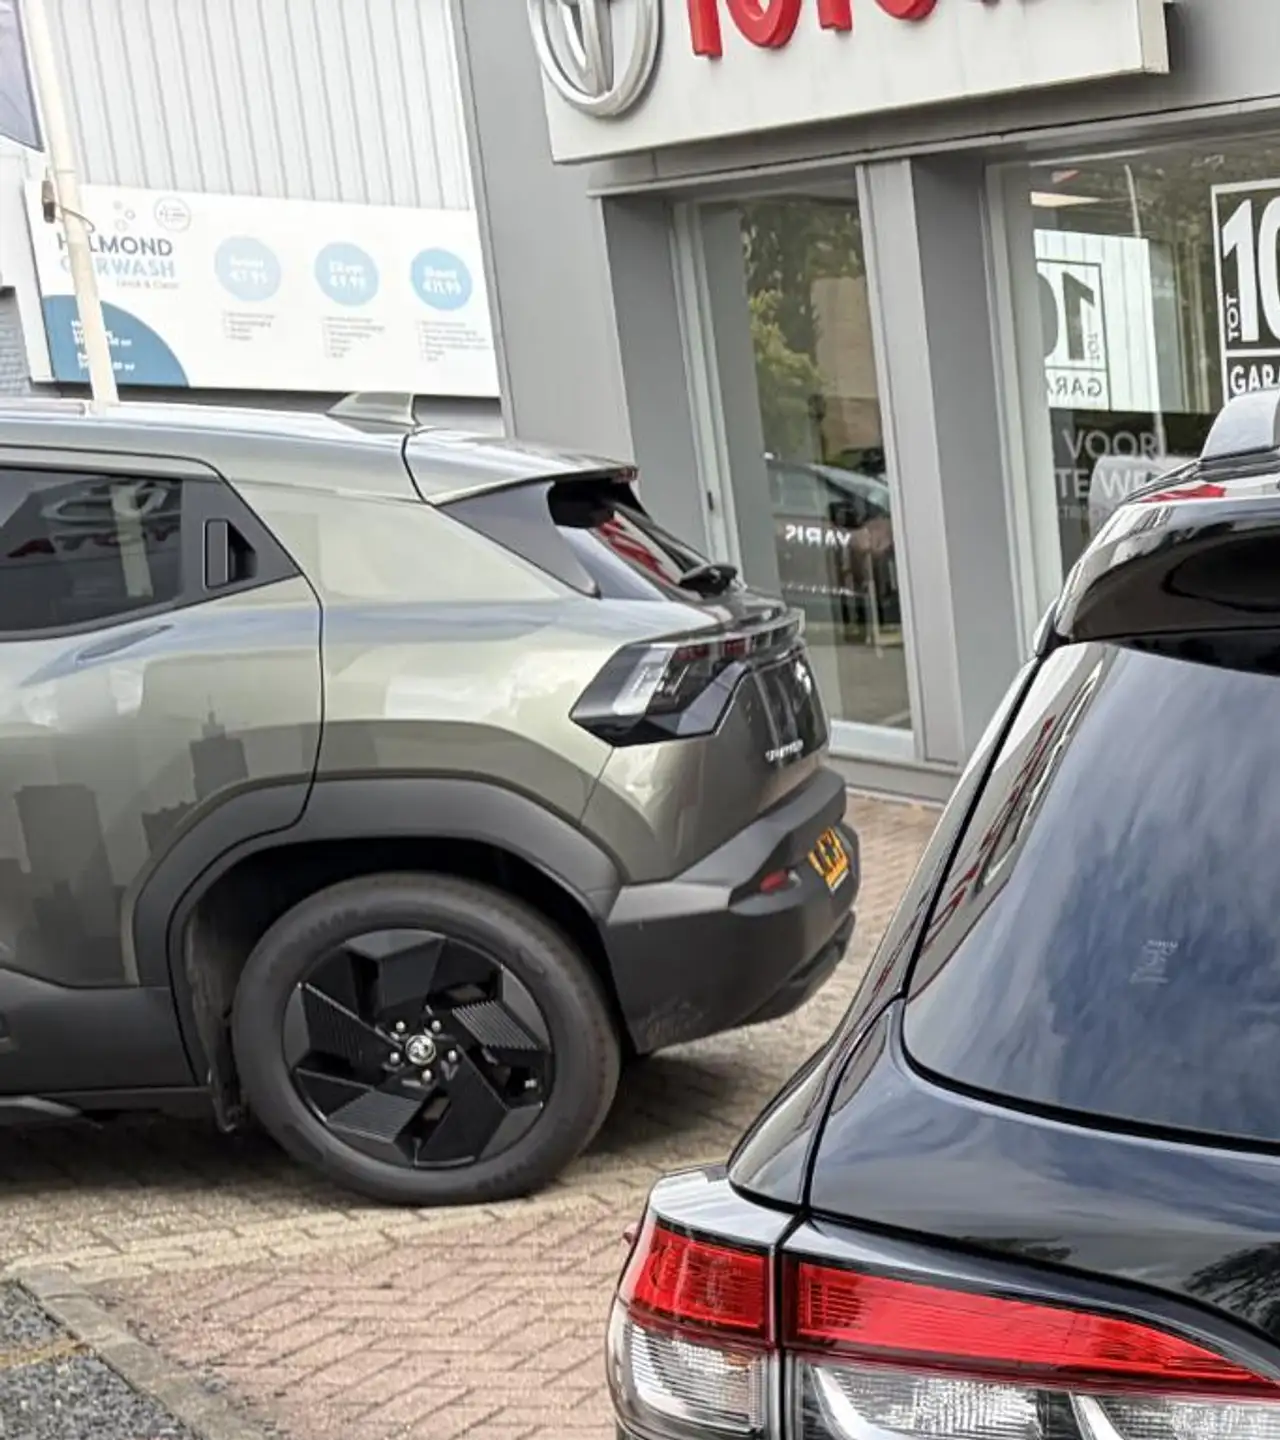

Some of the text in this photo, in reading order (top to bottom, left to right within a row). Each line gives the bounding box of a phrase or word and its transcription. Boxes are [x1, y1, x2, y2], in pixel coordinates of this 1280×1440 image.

[57, 232, 173, 256] HLMOND
[60, 254, 175, 278] CRWASH
[1226, 293, 1241, 343] TOT
[1061, 429, 1158, 461] VOOR
